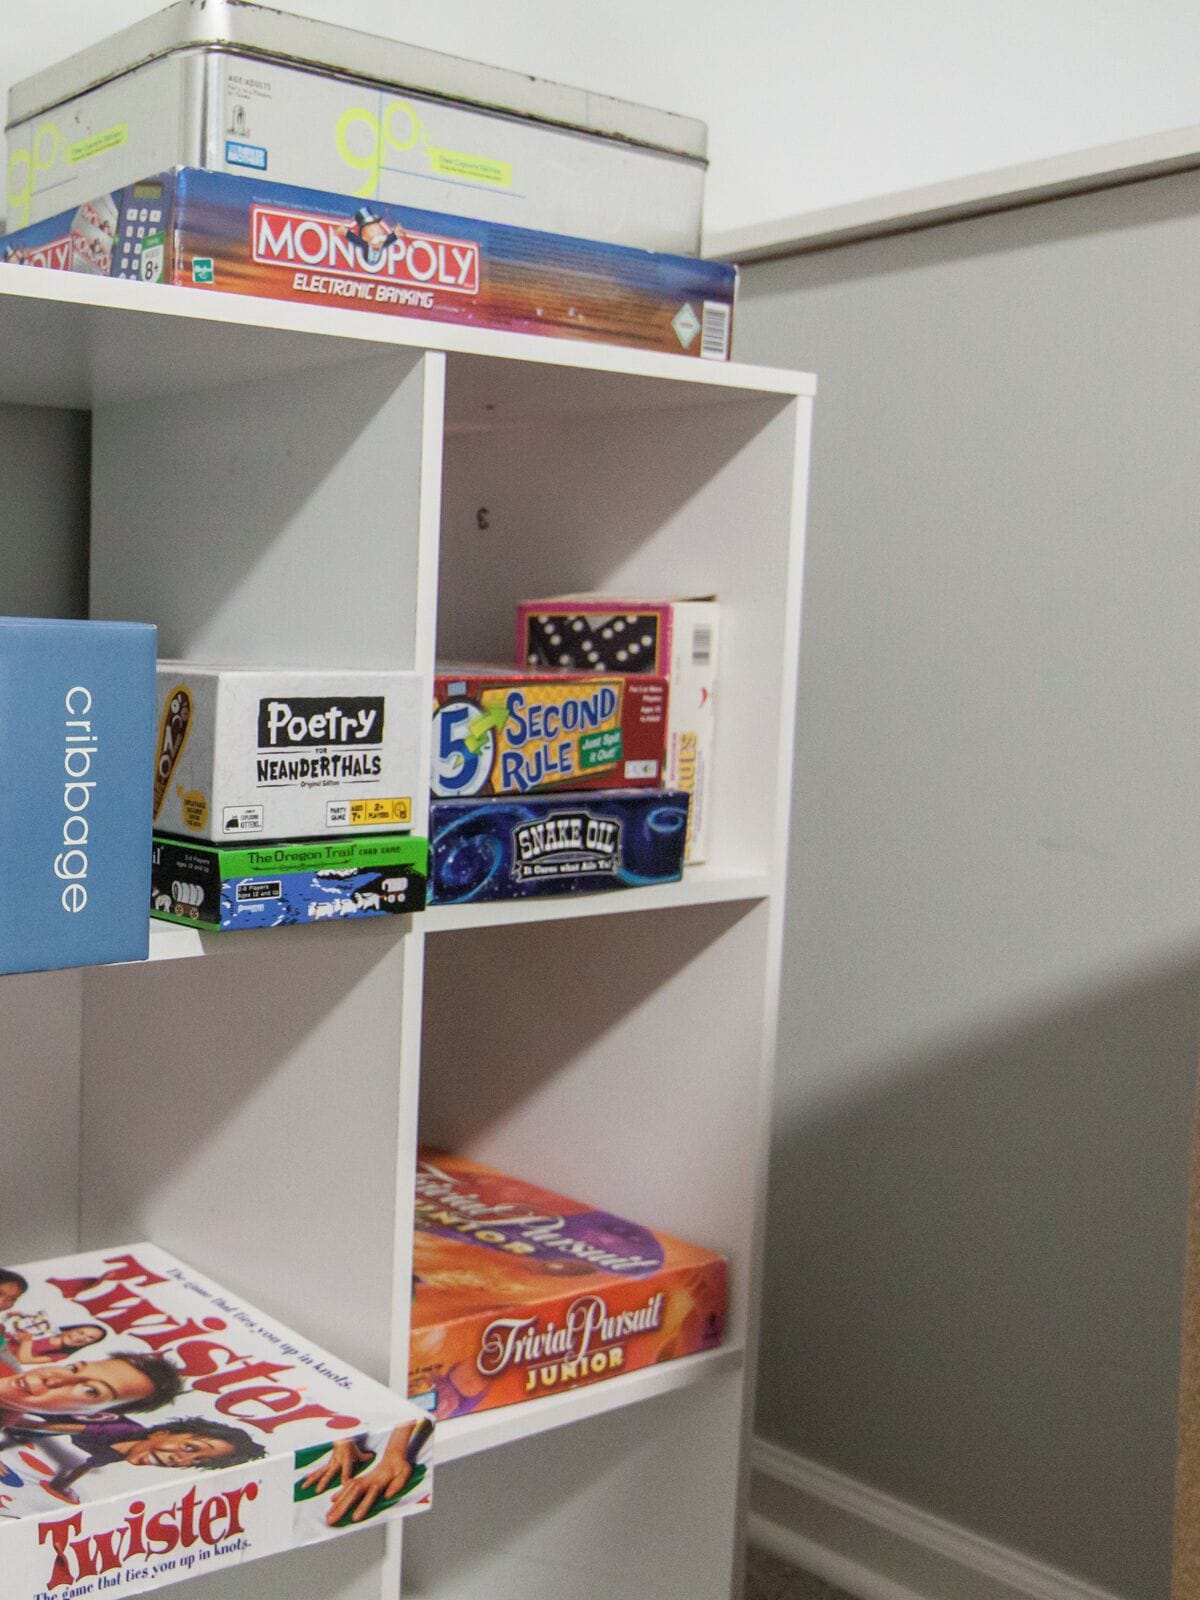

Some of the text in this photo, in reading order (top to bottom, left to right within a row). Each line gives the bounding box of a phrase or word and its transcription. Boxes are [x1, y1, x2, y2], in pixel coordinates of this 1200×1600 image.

[257, 214, 474, 285] MONOPOLY
[293, 273, 373, 301] ELECTRONIC
[375, 284, 435, 309] BANKING
[268, 701, 376, 745] Poetry
[505, 687, 617, 747] SECOND
[438, 706, 480, 790] 5
[582, 736, 602, 750] Just
[256, 754, 382, 782] NEANDERTHALS
[300, 779, 340, 789] Original Edition
[501, 741, 573, 793] RULE
[53, 685, 99, 914] cribbage
[352, 812, 362, 822] 7+
[368, 811, 390, 819] PLAYERS
[374, 803, 384, 812] 2+
[248, 851, 273, 864] The
[275, 848, 321, 864] Oregon
[325, 845, 355, 861] Trail
[518, 818, 618, 860] SNAKE OIL
[560, 862, 580, 873] what
[468, 1214, 661, 1271] Pursuit
[46, 1253, 362, 1434] Twister
[184, 1278, 213, 1301] game
[211, 1294, 237, 1315] that
[232, 1306, 256, 1329] ties
[251, 1323, 282, 1347] you
[280, 1340, 301, 1357] up
[299, 1351, 314, 1365] in
[312, 1361, 353, 1390] knots.
[477, 1294, 664, 1377] Trivial Pursuit
[525, 1347, 624, 1392] JUNIOR
[38, 1481, 259, 1591] Twister
[61, 1583, 94, 1600] game
[98, 1572, 121, 1591] that
[125, 1565, 149, 1582] ties
[151, 1561, 176, 1579] you
[179, 1555, 195, 1570] up
[198, 1548, 211, 1561] in
[213, 1536, 252, 1557] knots.
